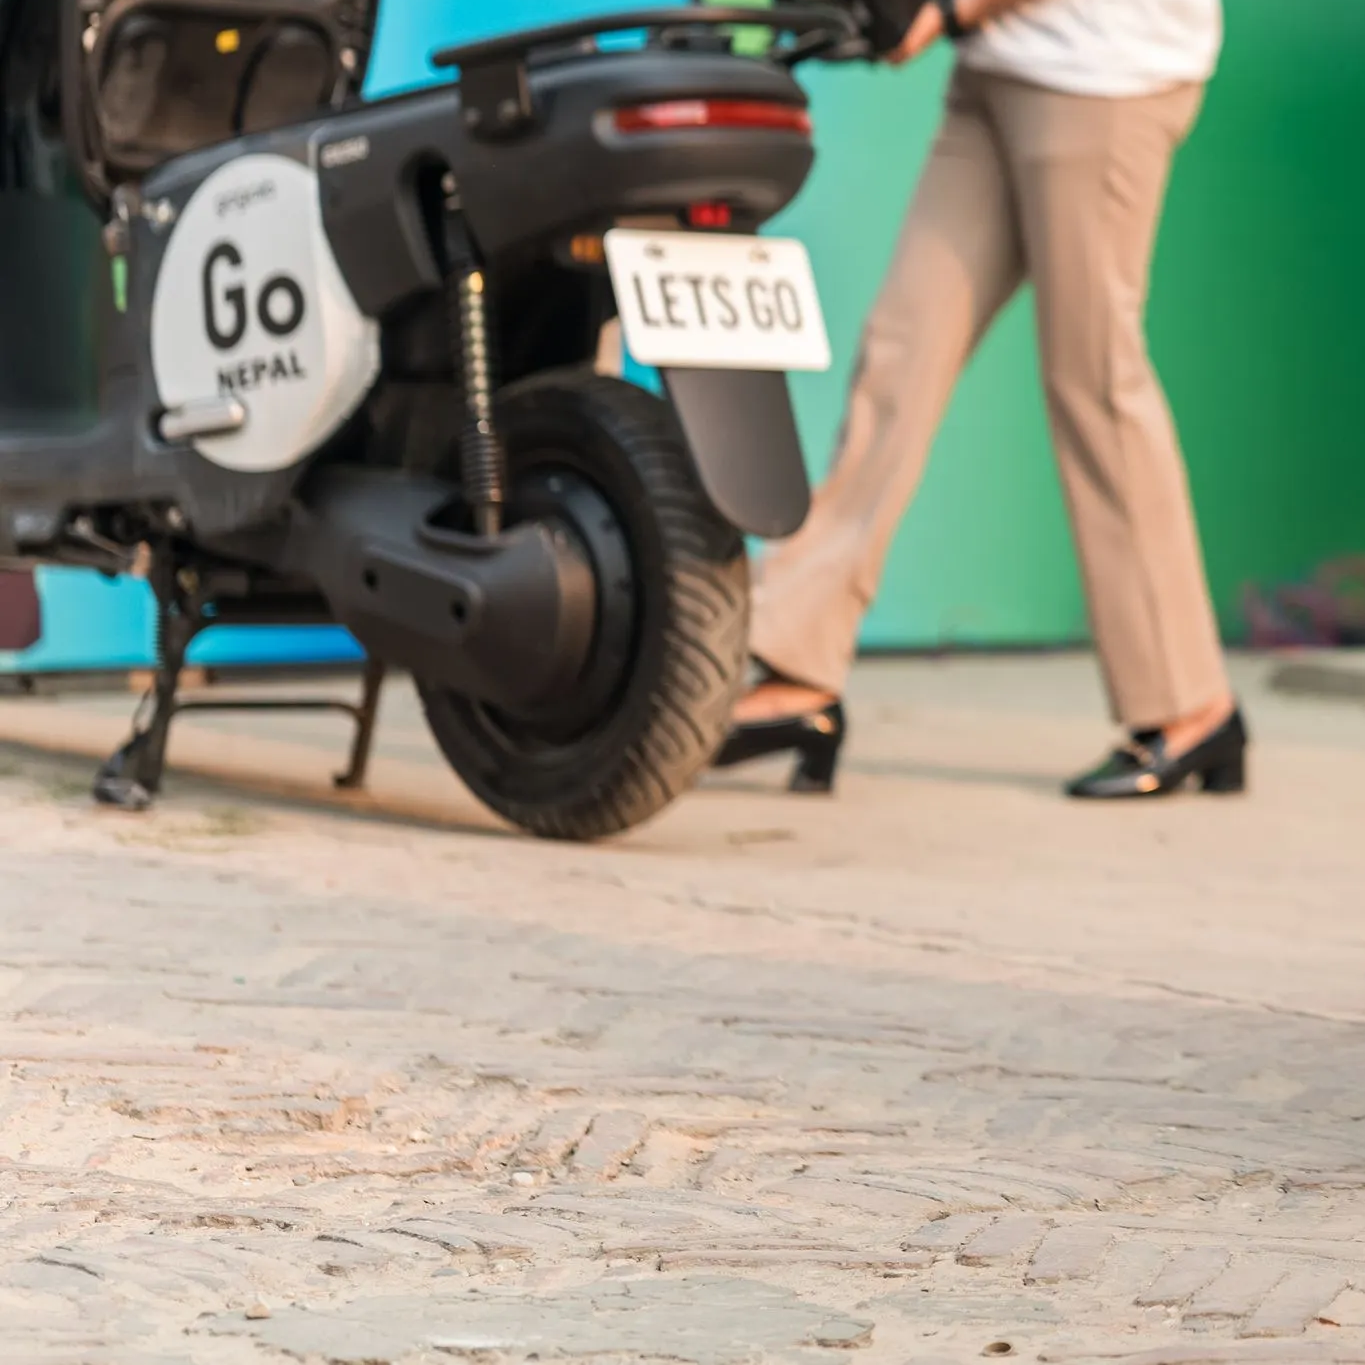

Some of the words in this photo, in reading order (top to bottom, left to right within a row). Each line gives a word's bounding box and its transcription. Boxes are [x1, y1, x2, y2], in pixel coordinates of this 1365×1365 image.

[203, 241, 306, 350] Go
[630, 272, 740, 330] LETS
[746, 274, 806, 332] GO
[216, 351, 307, 396] NEPAL
